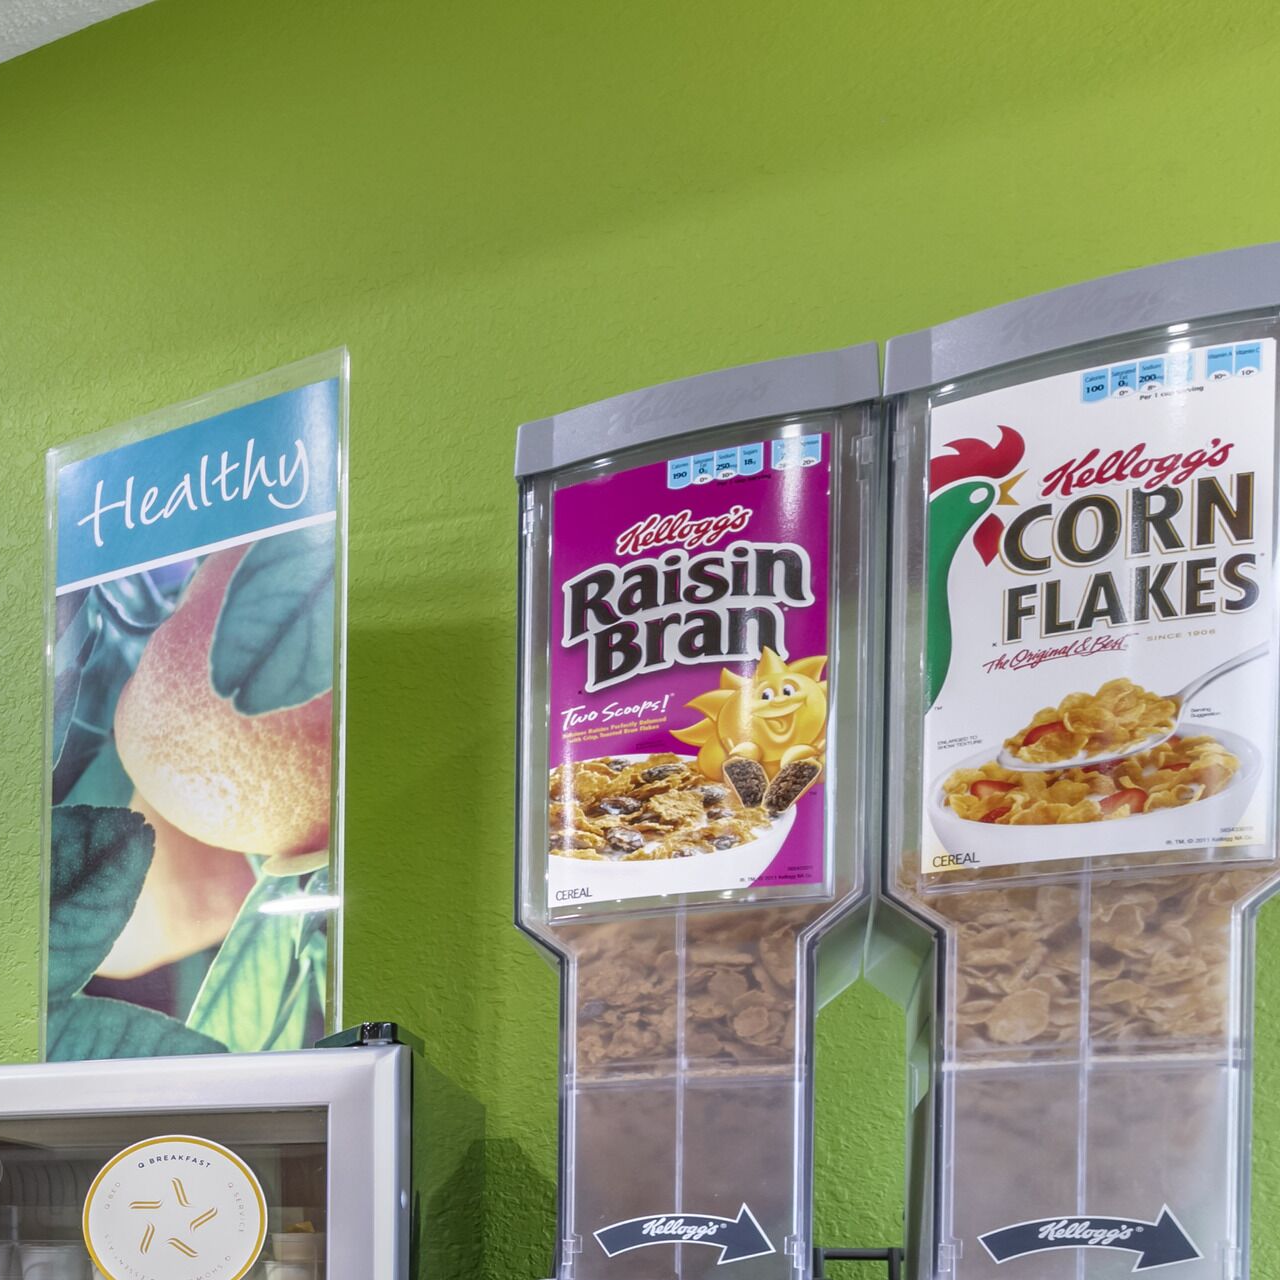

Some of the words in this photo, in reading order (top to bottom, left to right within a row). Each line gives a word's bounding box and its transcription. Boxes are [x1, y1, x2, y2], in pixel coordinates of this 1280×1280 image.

[1086, 383, 1104, 394] 100
[672, 471, 687, 479] 190
[1041, 438, 1234, 497] Kellogg's
[77, 438, 309, 547] Healthy
[617, 506, 751, 555] Kellogg's
[1000, 471, 1255, 575] CORN
[567, 546, 808, 641] Raisin
[1002, 553, 1260, 644] FLAKES
[592, 606, 782, 686] Bran
[982, 653, 1008, 673] The
[1009, 640, 1074, 670] Original
[1074, 636, 1092, 655] &
[1091, 632, 1135, 655] Best
[1146, 632, 1182, 642] SINCE
[561, 705, 598, 731] Two
[601, 694, 669, 722] Scoops!
[932, 852, 980, 868] CEREAL
[555, 887, 592, 901] CEREAL
[137, 1161, 145, 1169] Q
[149, 1154, 212, 1169] BREAKFAST
[234, 1192, 245, 1233] SERVICE
[642, 1217, 720, 1240] Kellogg's
[1038, 1222, 1135, 1245] Kellogg's
